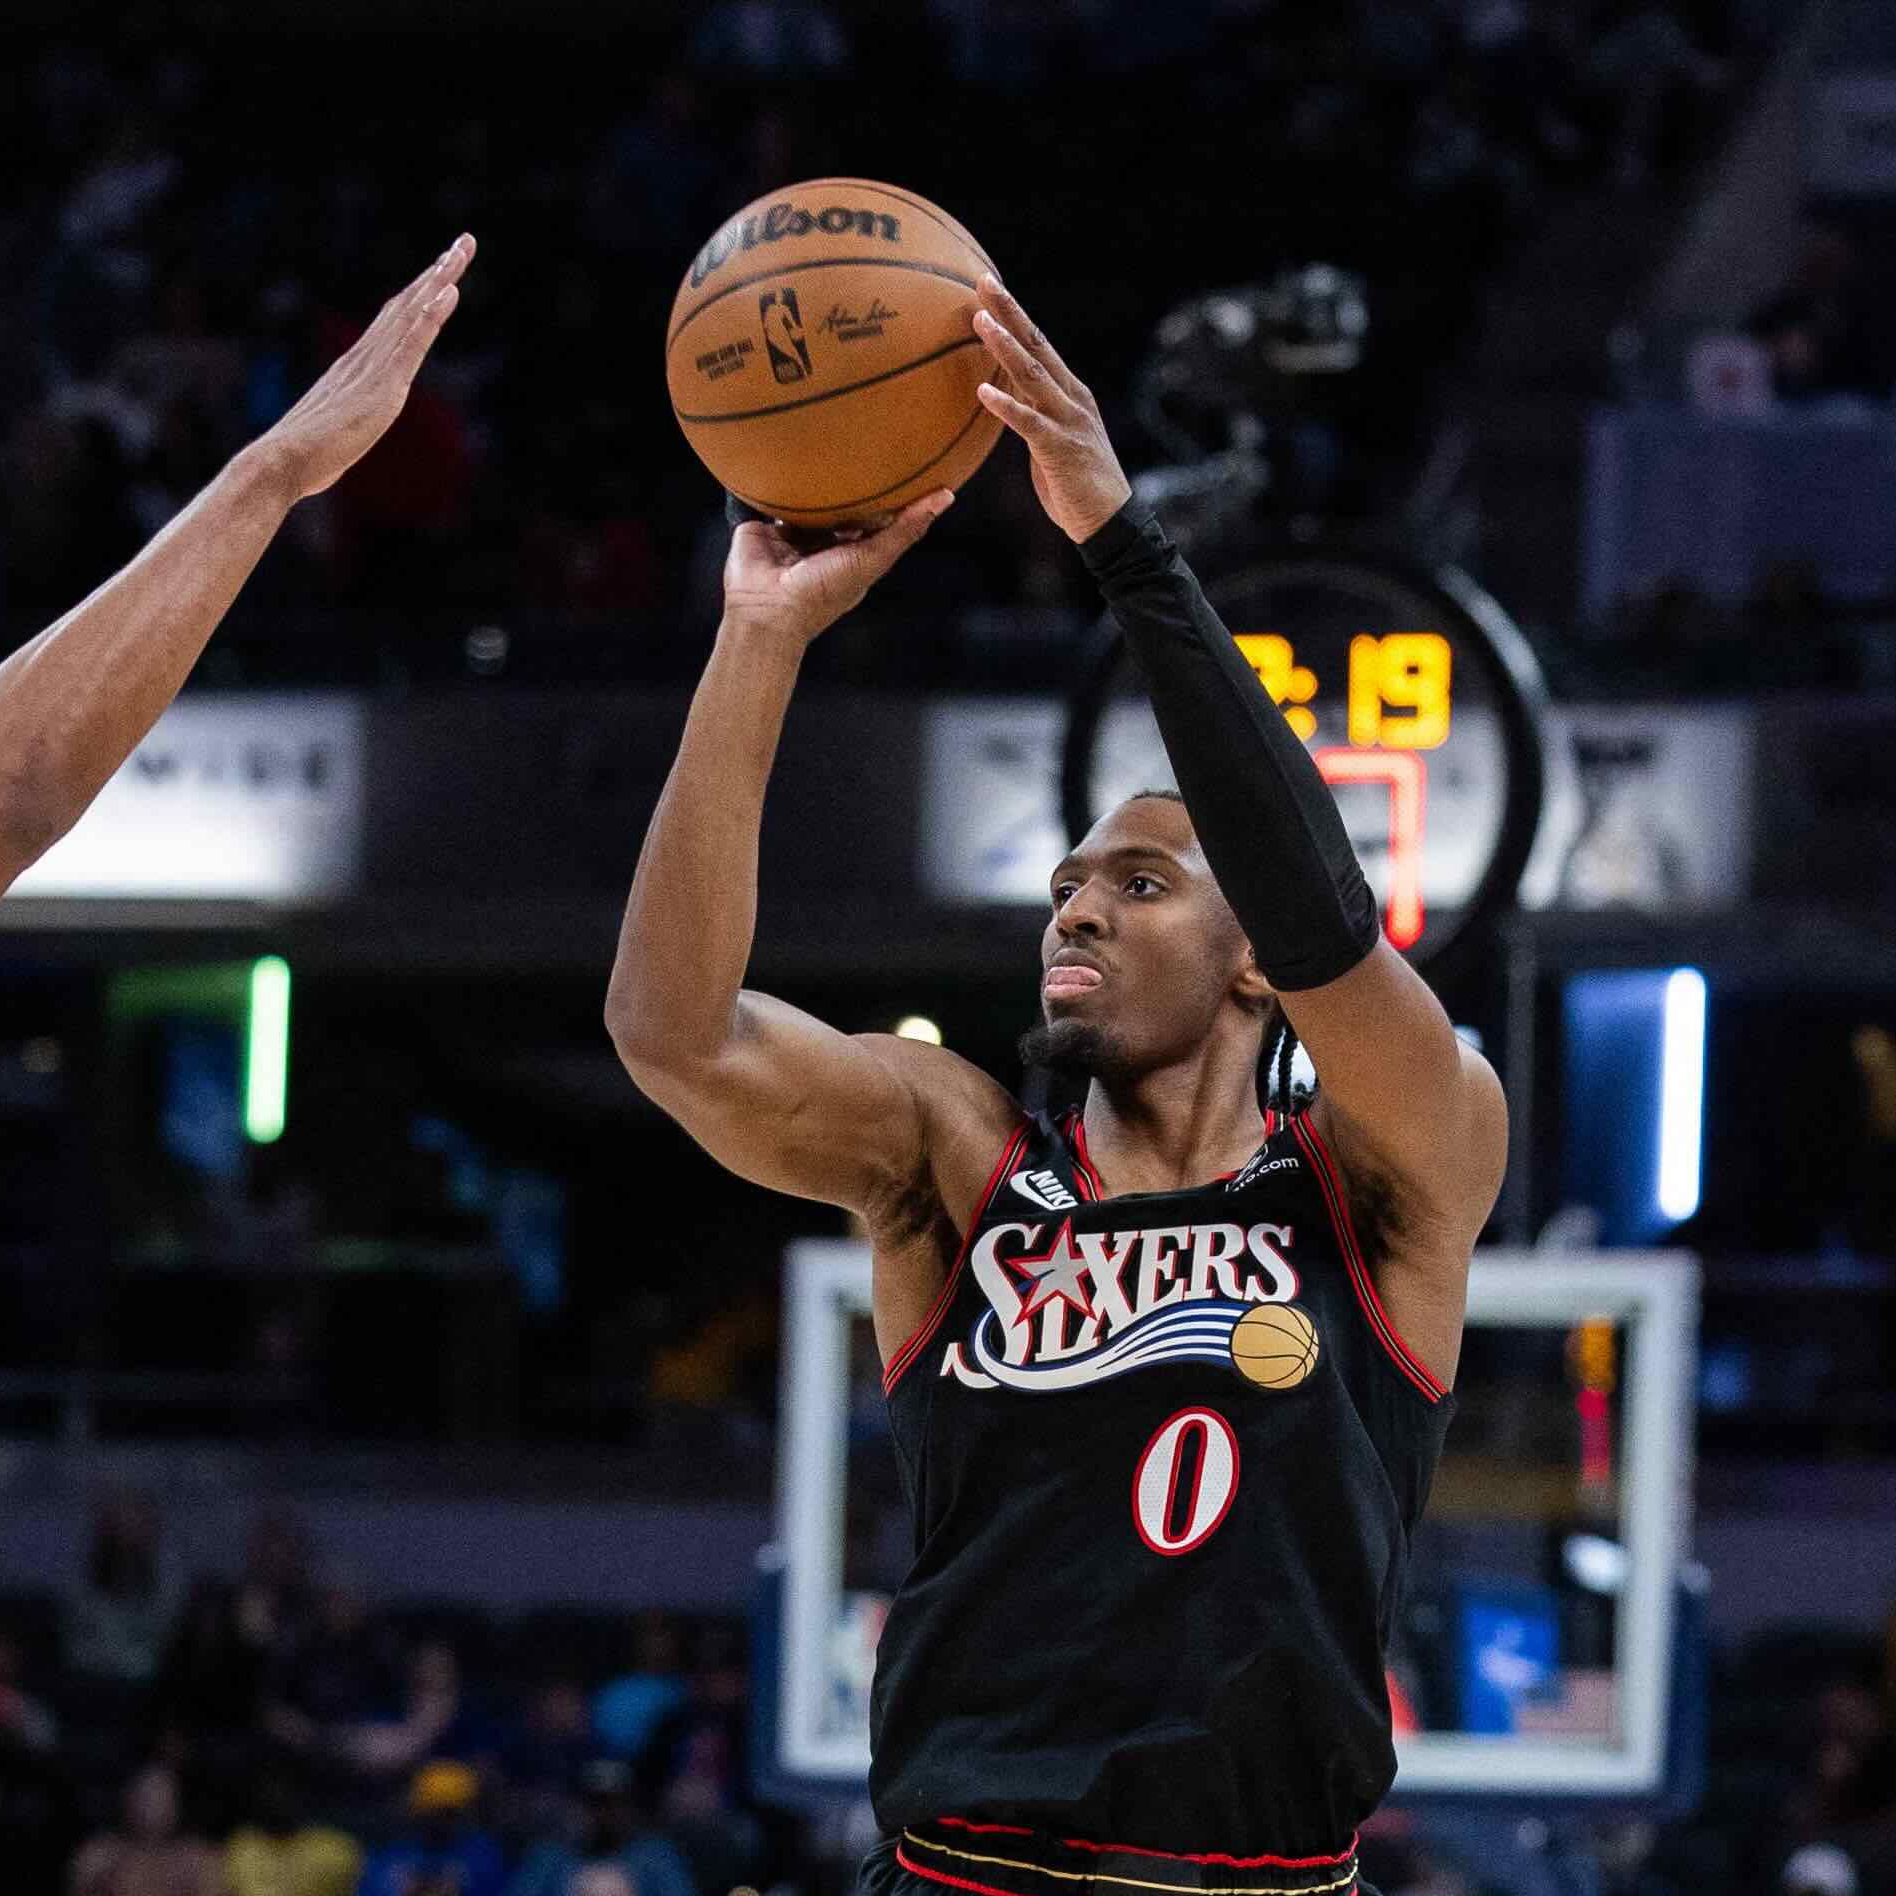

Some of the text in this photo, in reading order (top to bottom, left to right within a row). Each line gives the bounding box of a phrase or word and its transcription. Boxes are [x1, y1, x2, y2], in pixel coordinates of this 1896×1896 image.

[690, 203, 902, 288] Wilson
[1312, 747, 1428, 951] 7
[940, 1216, 1305, 1389] SIXERS
[1131, 1406, 1240, 1556] 0
